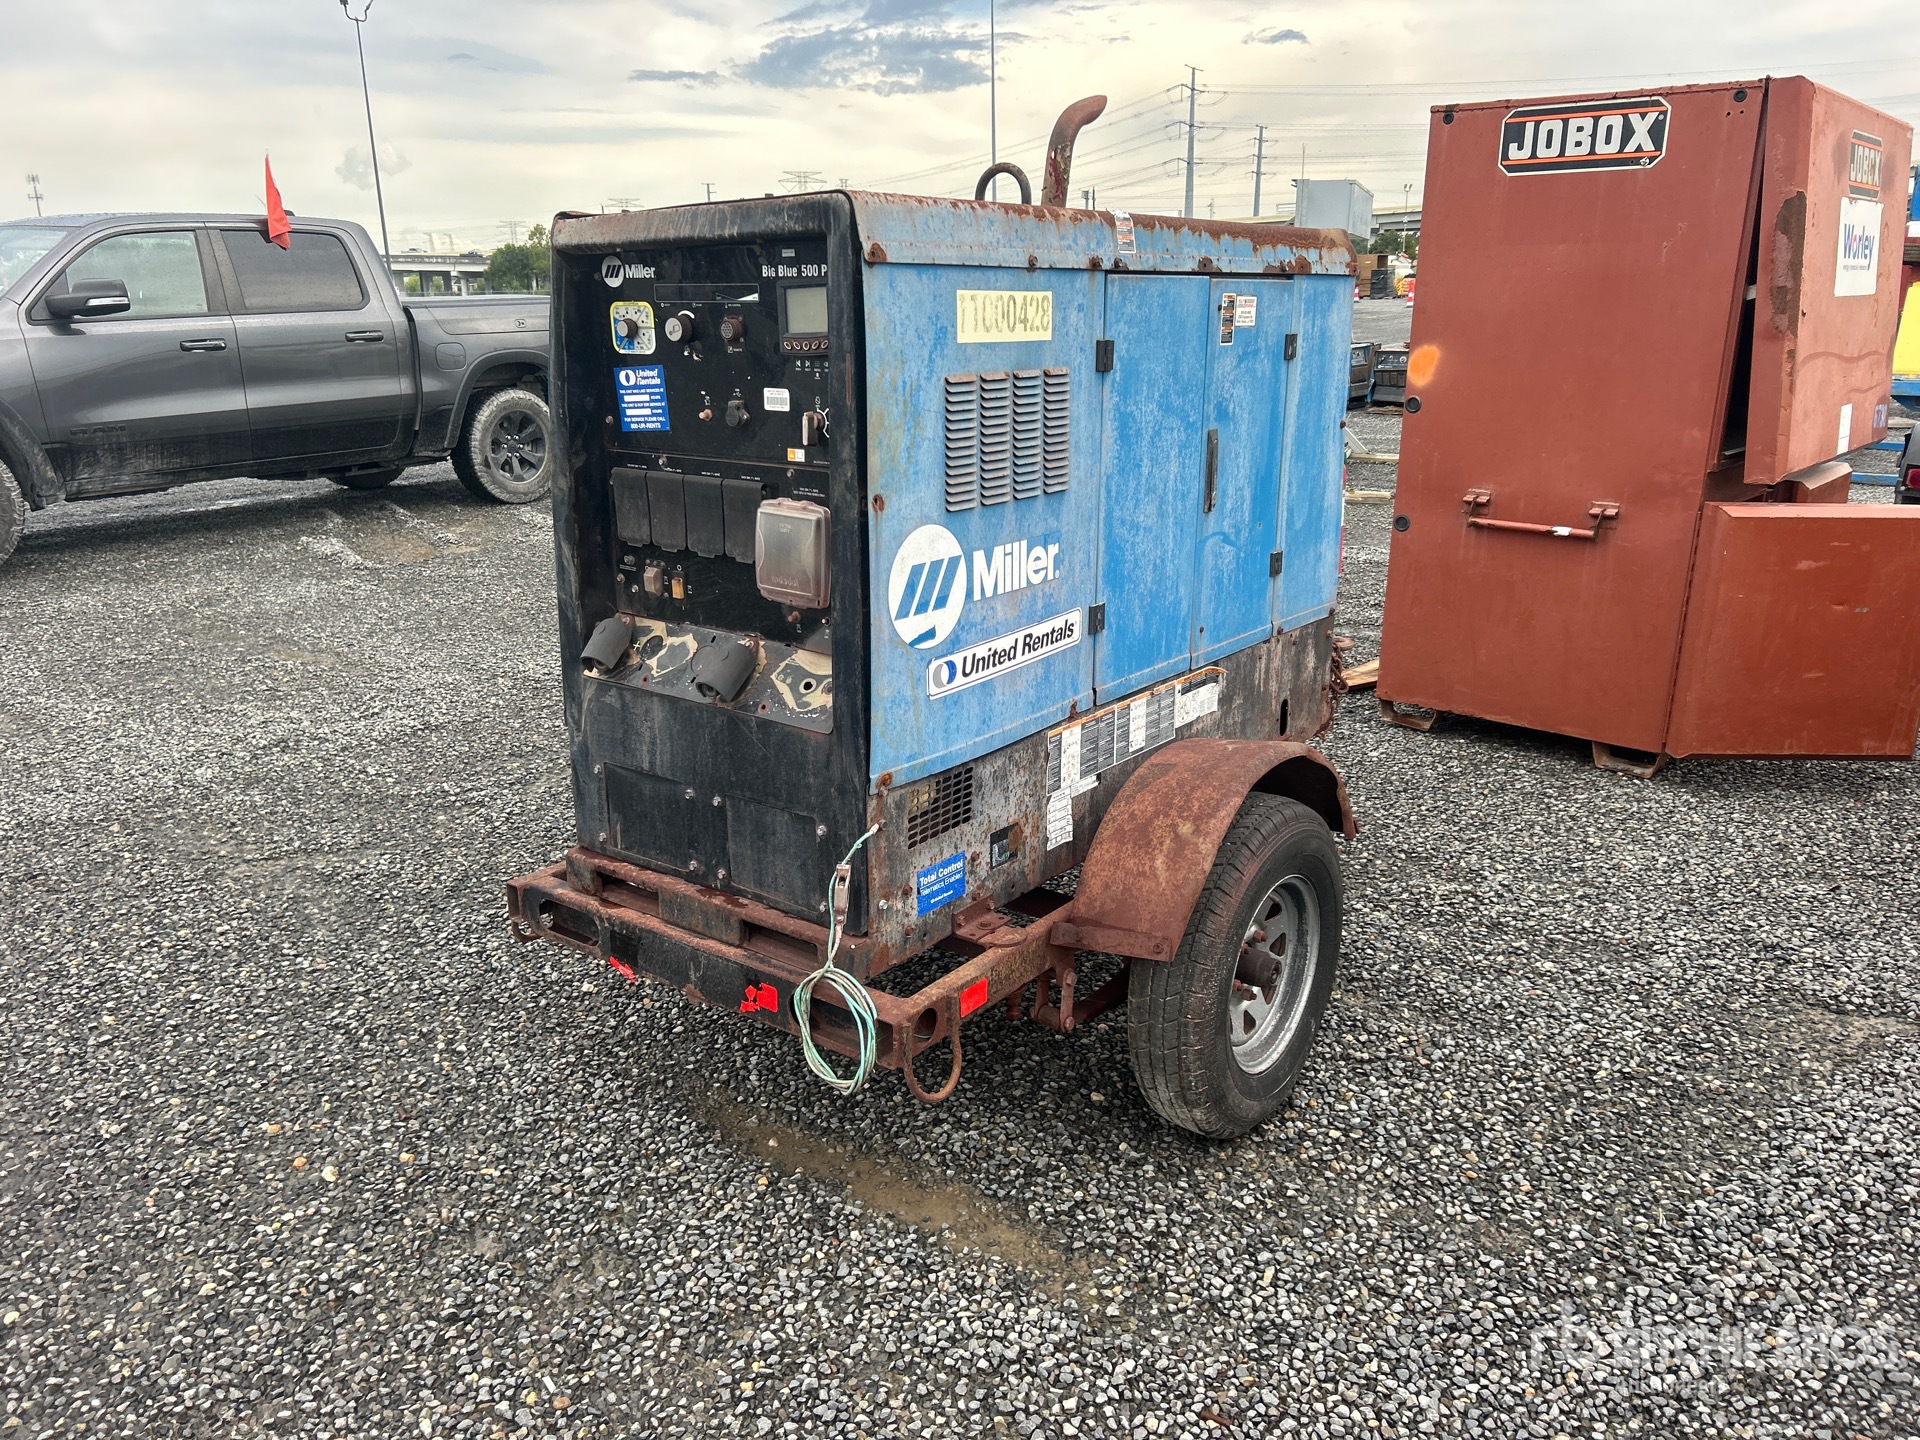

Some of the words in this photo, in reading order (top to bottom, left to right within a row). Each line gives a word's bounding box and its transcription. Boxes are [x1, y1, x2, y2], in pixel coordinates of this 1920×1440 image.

[1508, 111, 1660, 160] JOBOX
[1843, 223, 1875, 271] Worley
[625, 264, 656, 279] Miller
[762, 264, 776, 280] Big
[778, 264, 797, 277] Blue
[801, 264, 819, 277] 500
[636, 369, 658, 377] United
[972, 539, 1060, 602] Miller
[961, 638, 1019, 678] United
[1021, 618, 1075, 657] Rentals
[920, 871, 937, 886] Total
[938, 859, 964, 878] Control
